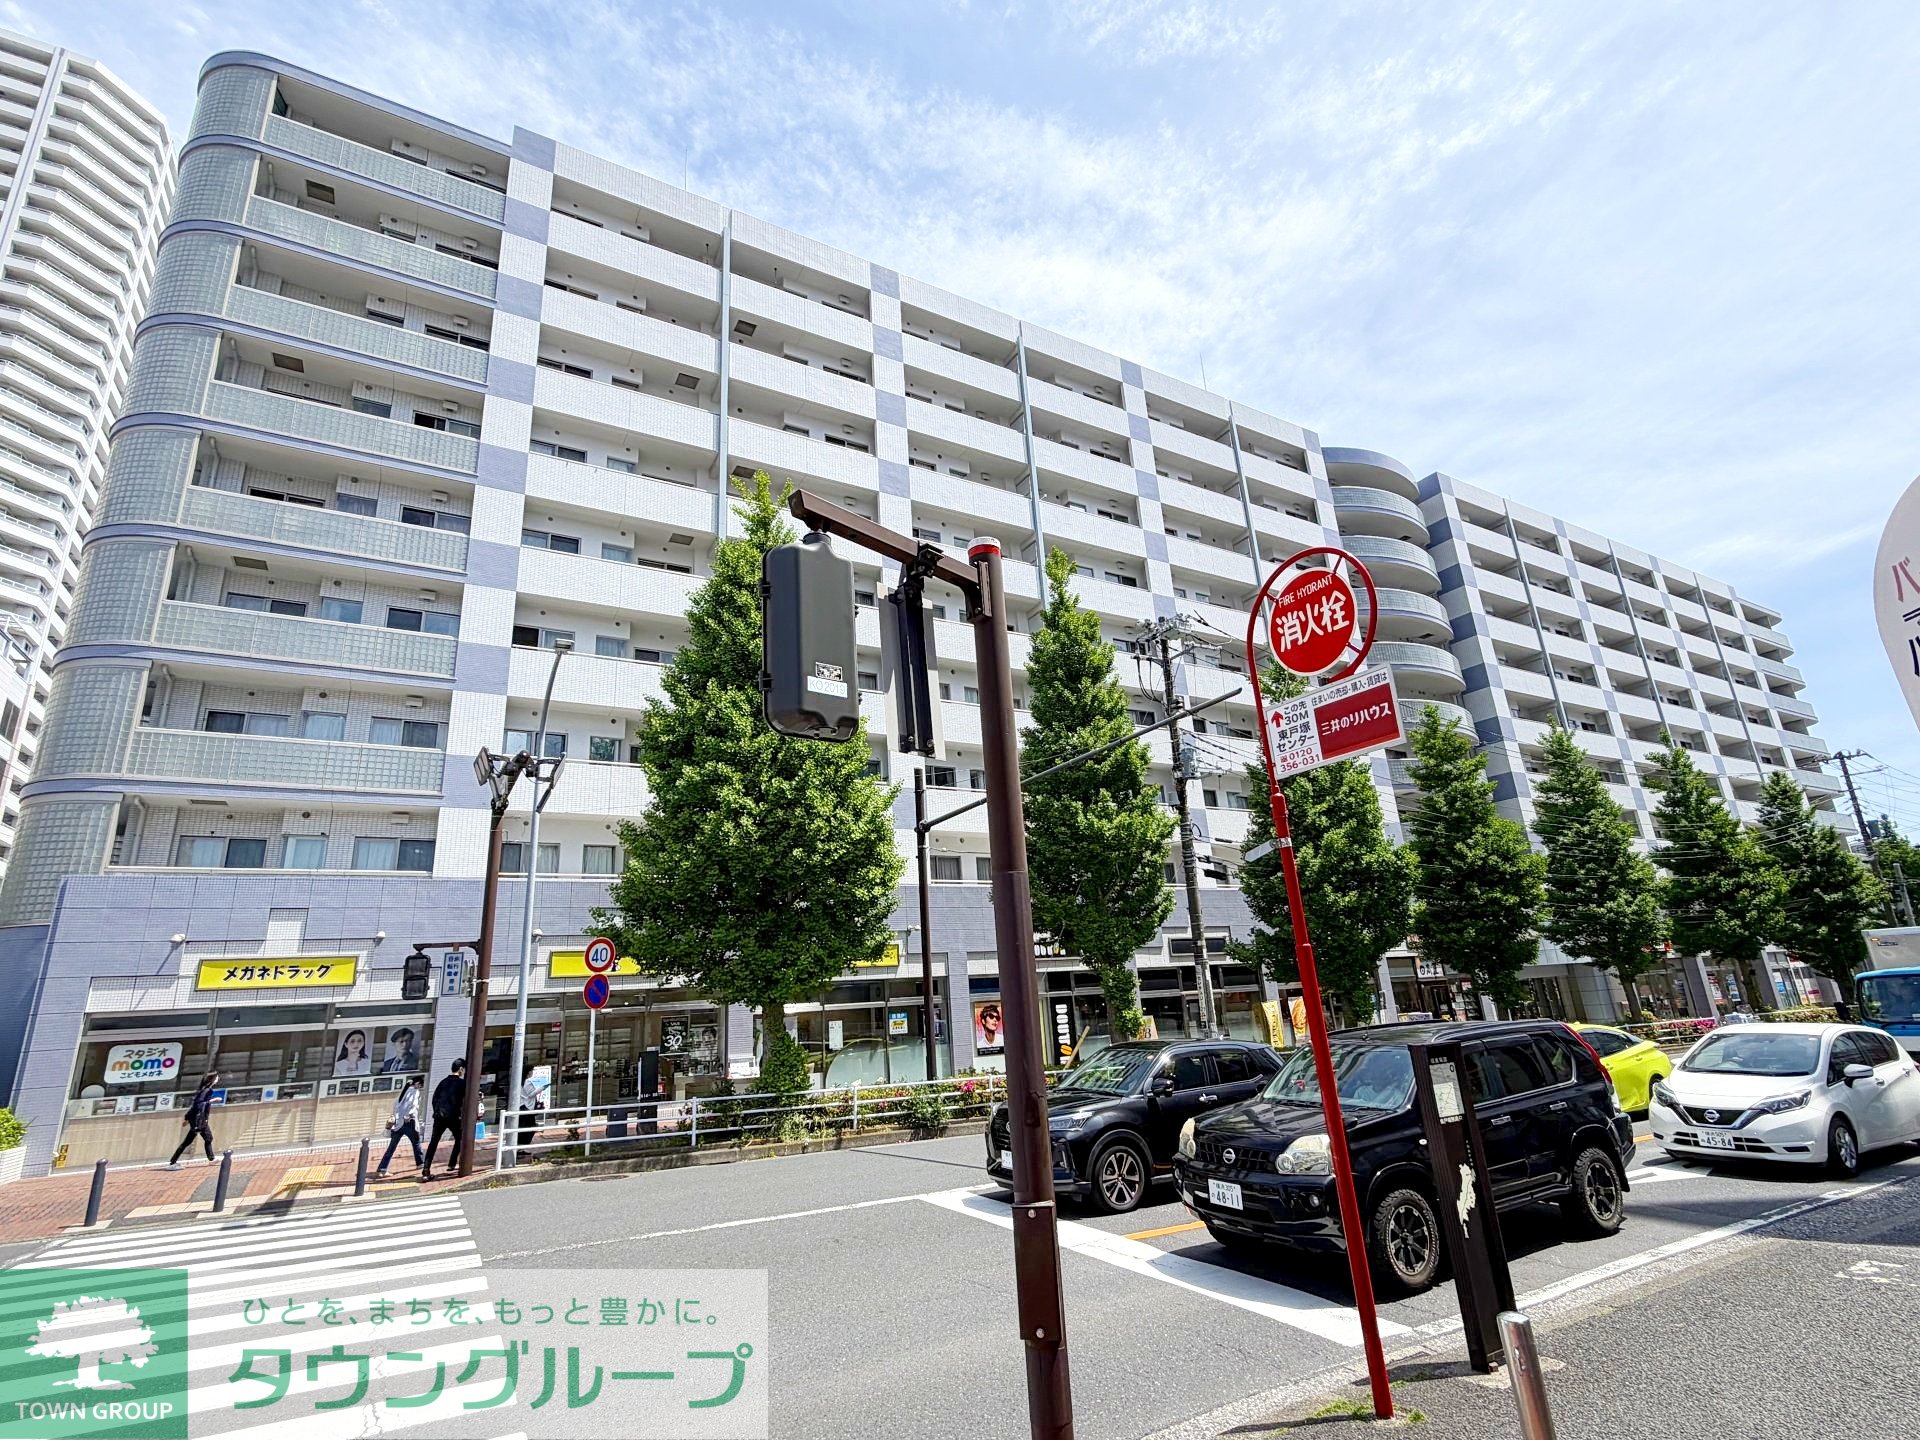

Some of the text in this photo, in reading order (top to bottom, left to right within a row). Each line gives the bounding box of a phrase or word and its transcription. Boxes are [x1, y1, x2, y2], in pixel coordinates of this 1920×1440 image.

[1278, 573, 1334, 608] FIRE HYDRANT
[1275, 590, 1350, 653] 消火栓
[1283, 699, 1308, 717] この先
[1284, 708, 1309, 726] 30M
[1321, 702, 1392, 736] 三井のリハウス
[1277, 723, 1311, 743] 東戸塚
[1276, 734, 1314, 754] センター
[1289, 747, 1313, 761] 0120
[1280, 754, 1320, 773] 356-031
[591, 947, 609, 963] 40
[223, 963, 335, 982] メガネドラッグ
[664, 1035, 682, 1047] 30
[123, 1047, 169, 1059] スタジオ
[111, 1057, 175, 1072] momo
[1706, 1136, 1732, 1147] 45-84
[1216, 1190, 1240, 1207] 48-11
